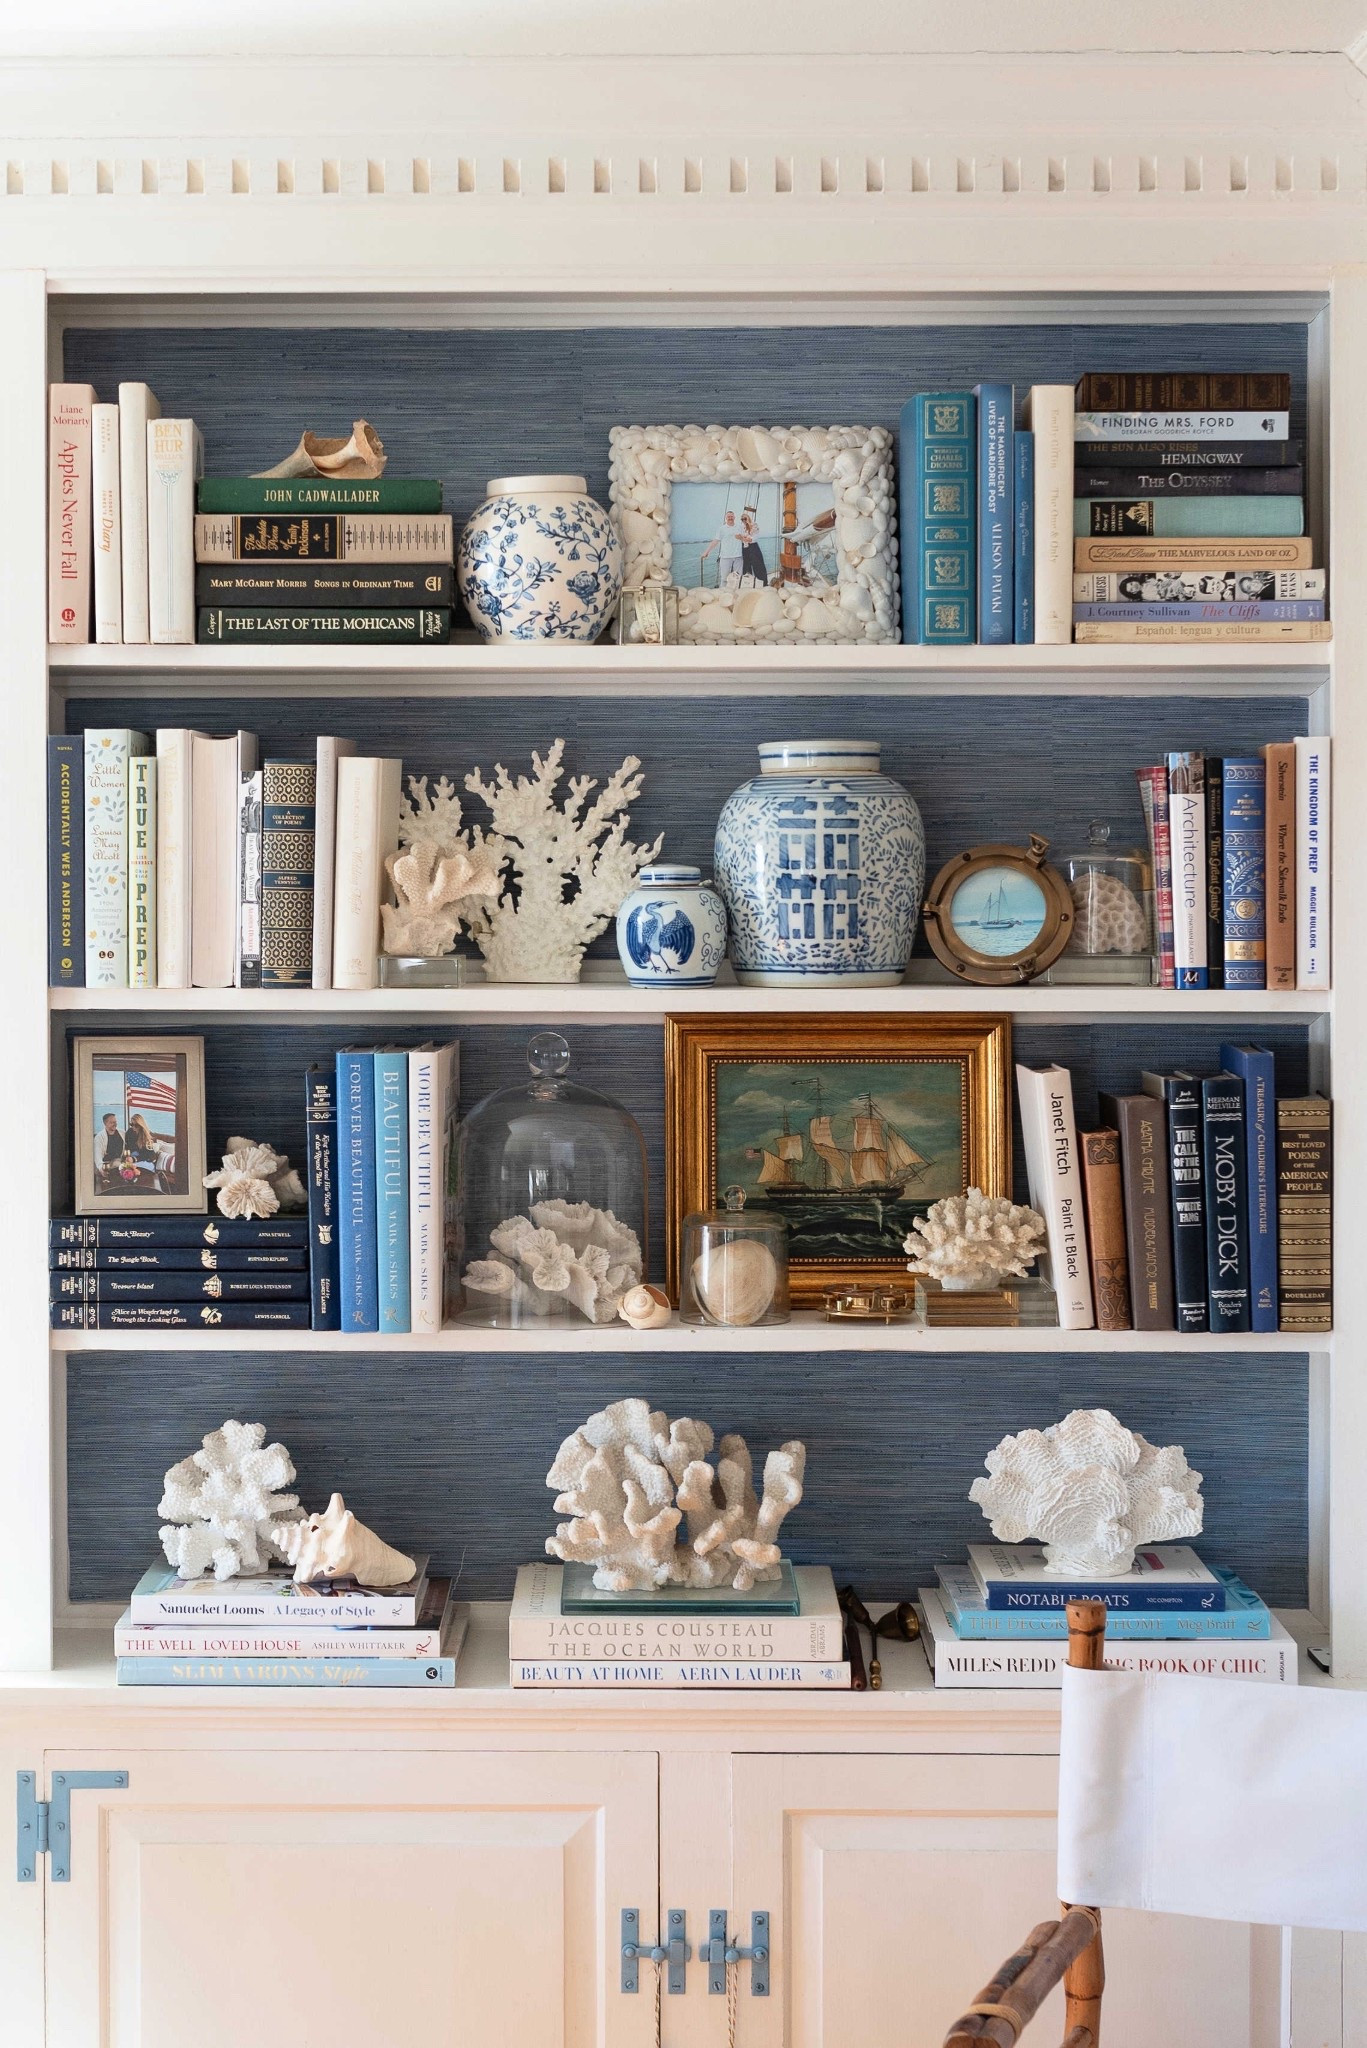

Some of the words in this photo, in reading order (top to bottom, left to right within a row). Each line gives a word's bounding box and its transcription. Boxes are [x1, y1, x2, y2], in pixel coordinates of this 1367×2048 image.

[60, 405, 83, 414] Liane
[53, 417, 90, 427] Moriarty
[1102, 418, 1158, 428] FINDING
[1165, 418, 1193, 427] MRS.
[1200, 418, 1234, 427] FORD
[989, 428, 995, 440] OF
[988, 442, 996, 490] MARJORIE
[997, 433, 1005, 498] MAGNIFICENT
[1162, 453, 1243, 464] HEMINGWAY
[58, 440, 79, 495] Apples
[1138, 476, 1164, 488] THE
[1169, 473, 1232, 488] ODYSSEY
[264, 491, 293, 502] JOHN
[298, 490, 380, 502] CADWALLADER
[61, 500, 78, 546] Never
[287, 524, 300, 544] Emily
[299, 520, 309, 555] Dickinson
[991, 522, 1002, 570] ALLISON
[61, 551, 77, 579] Fall
[315, 580, 339, 588] SONGS
[353, 580, 391, 588] ORDINARY
[393, 580, 413, 588] TIME
[1096, 575, 1106, 602] NEMESIS
[992, 575, 1002, 613] PATAKI
[1088, 608, 1095, 616] J.
[1098, 607, 1144, 619] Courtney
[1148, 606, 1190, 616] Sullivan
[1202, 606, 1224, 617] The
[1228, 605, 1260, 620] Cliffs
[207, 614, 215, 634] Cooper
[226, 619, 255, 629] THE
[257, 619, 289, 629] LAST
[292, 619, 310, 629] OF
[311, 619, 340, 629] THE
[343, 618, 415, 629] MOHICANS
[1180, 626, 1212, 637] lengua
[1217, 628, 1223, 637] y
[1226, 626, 1261, 635] cultura
[91, 763, 121, 775] Little
[1309, 755, 1318, 774] THE
[87, 776, 125, 788] Women
[1278, 761, 1288, 801] Silverstein
[61, 763, 70, 848] ACCIDENTALLY
[136, 764, 147, 848] TRUE
[1309, 777, 1318, 825] KINGDOM
[90, 825, 122, 836] Louisa
[1279, 823, 1287, 846] Where
[1309, 829, 1318, 843] OF
[94, 838, 120, 850] May
[92, 851, 121, 861] Alcott
[1182, 797, 1198, 909] Architecture
[1309, 846, 1318, 873] PREP
[61, 852, 70, 876] WES
[1279, 865, 1288, 901] Sidewalk
[62, 881, 70, 947] ANDERSON
[1279, 902, 1288, 923] Ends
[136, 883, 147, 967] PREP
[418, 1065, 430, 1114] MORE
[350, 1064, 361, 1134] FOREVER
[1208, 1096, 1240, 1104] HERMAN
[1051, 1092, 1065, 1134] Janet
[383, 1071, 400, 1201] BEAUTIFUL
[1176, 1130, 1195, 1141] THE
[1054, 1136, 1071, 1176] Fitch
[1174, 1144, 1198, 1155] CALL
[418, 1119, 431, 1213] BEAUTIFUL
[1174, 1159, 1185, 1167] OF
[1186, 1158, 1199, 1167] THE
[351, 1135, 363, 1224] BEAUTIFUL
[1174, 1169, 1200, 1181] WILD
[1215, 1136, 1236, 1208] MOBY
[1280, 1171, 1328, 1180] AMERICAN
[1286, 1183, 1322, 1191] PEOPLE
[1061, 1198, 1073, 1230] Paint
[1176, 1202, 1201, 1211] WHITE
[1259, 1184, 1267, 1233] LITERATURE
[1180, 1212, 1199, 1222] FANG
[1064, 1232, 1075, 1242] It
[1218, 1215, 1238, 1277] DICK
[1065, 1245, 1078, 1278] Black
[1218, 1301, 1242, 1309] Reader's
[159, 1603, 220, 1615] Nantucket
[223, 1604, 264, 1615] Looms
[273, 1606, 282, 1616] A
[285, 1606, 328, 1618] Legacy
[331, 1605, 343, 1616] of
[345, 1605, 376, 1618] Style
[548, 1622, 645, 1638] JACQUES
[657, 1622, 773, 1637] COUSTEAU
[1177, 1617, 1202, 1631] Meg
[1205, 1617, 1237, 1630] Braff
[124, 1639, 155, 1651] THE
[159, 1640, 196, 1651] WELL
[203, 1640, 251, 1651] LOVED
[254, 1640, 302, 1651] HOUSE
[312, 1642, 346, 1650] ASHLEY
[349, 1642, 406, 1650] WHITTAKER
[548, 1643, 591, 1656] THE
[604, 1643, 681, 1657] OCEAN
[694, 1643, 774, 1657] WORLD
[948, 1658, 1001, 1672] MILES
[1007, 1658, 1056, 1672] REDD
[1198, 1659, 1217, 1673] OF
[1221, 1659, 1265, 1673] CHIC
[172, 1665, 224, 1679] SLIM
[231, 1665, 315, 1679] AARONS
[321, 1664, 370, 1685] Style
[521, 1667, 585, 1681] BEAUTY
[589, 1667, 610, 1681] AT
[614, 1667, 663, 1681] HOME
[677, 1667, 730, 1681] AERIN
[735, 1667, 802, 1681] LAUDER
